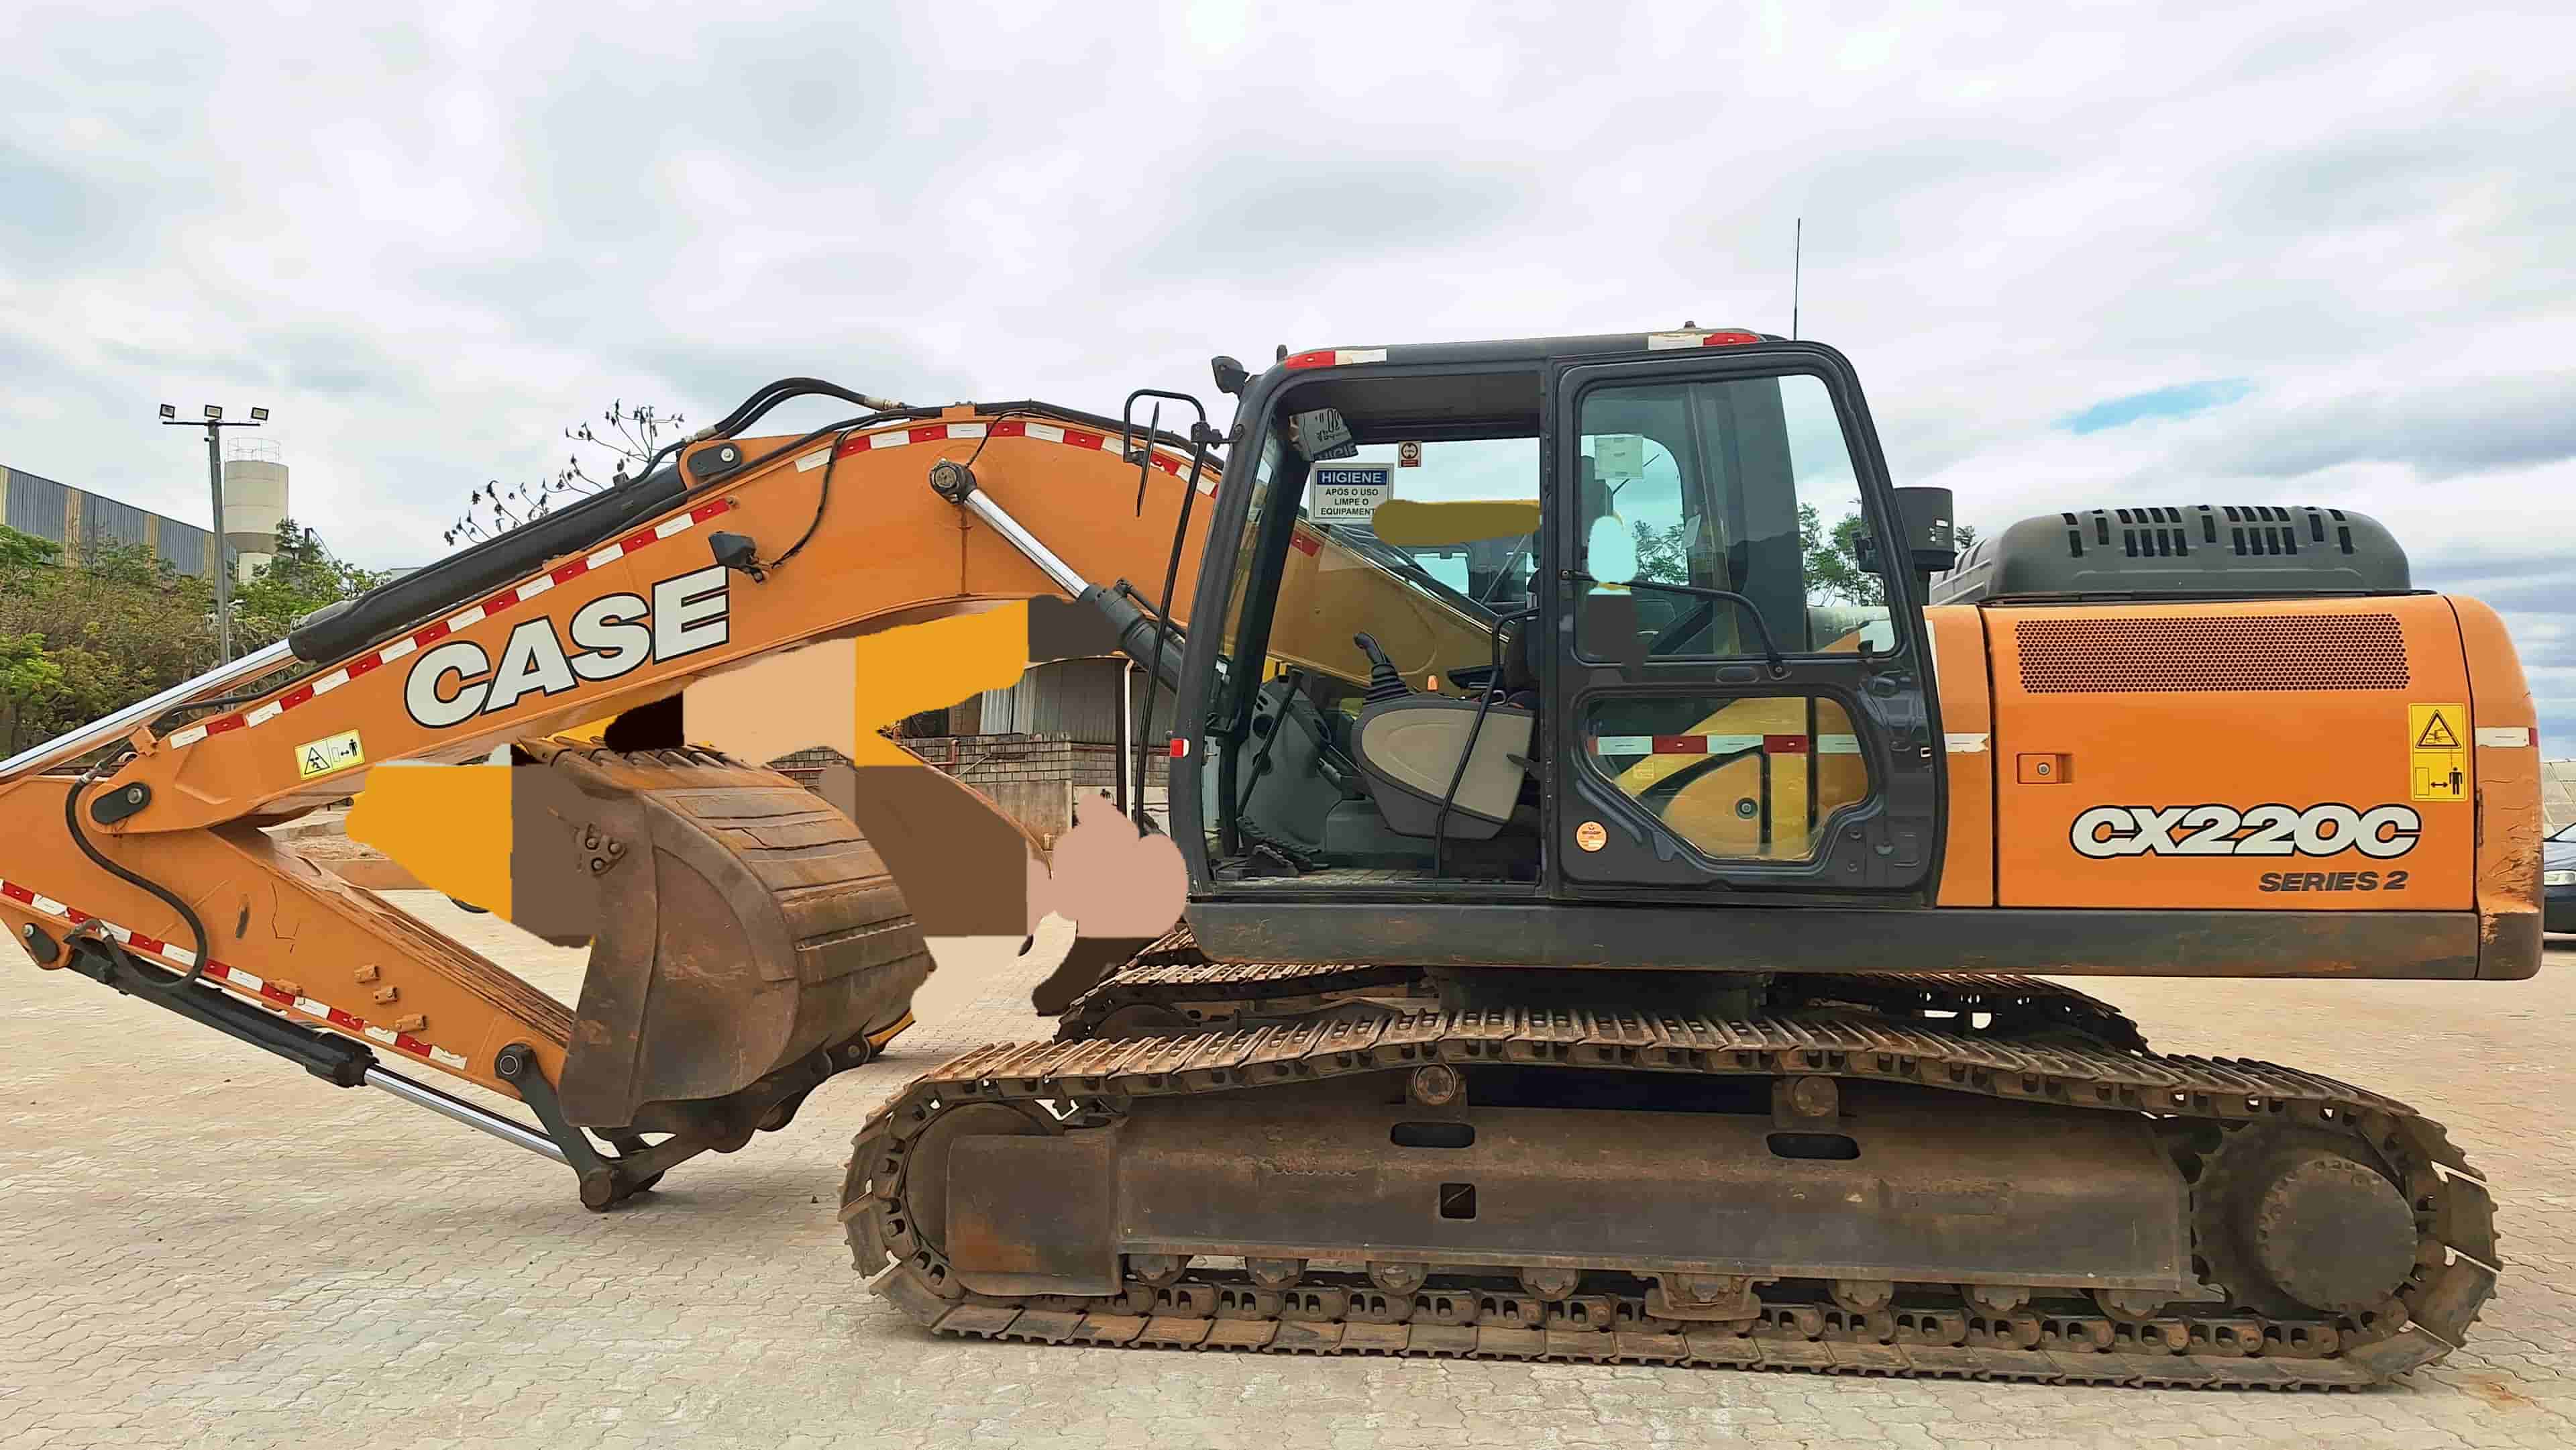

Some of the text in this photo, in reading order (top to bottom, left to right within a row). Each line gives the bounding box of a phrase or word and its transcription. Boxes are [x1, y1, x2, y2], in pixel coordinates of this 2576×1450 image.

[1322, 472, 1382, 483] HIGIENE
[1334, 498, 1360, 506] LIMPE
[1320, 508, 1375, 516] EQUIPAMENT
[404, 564, 730, 729] CASE
[2070, 802, 2422, 860] CX220C
[2259, 870, 2410, 892] SERIES 2
